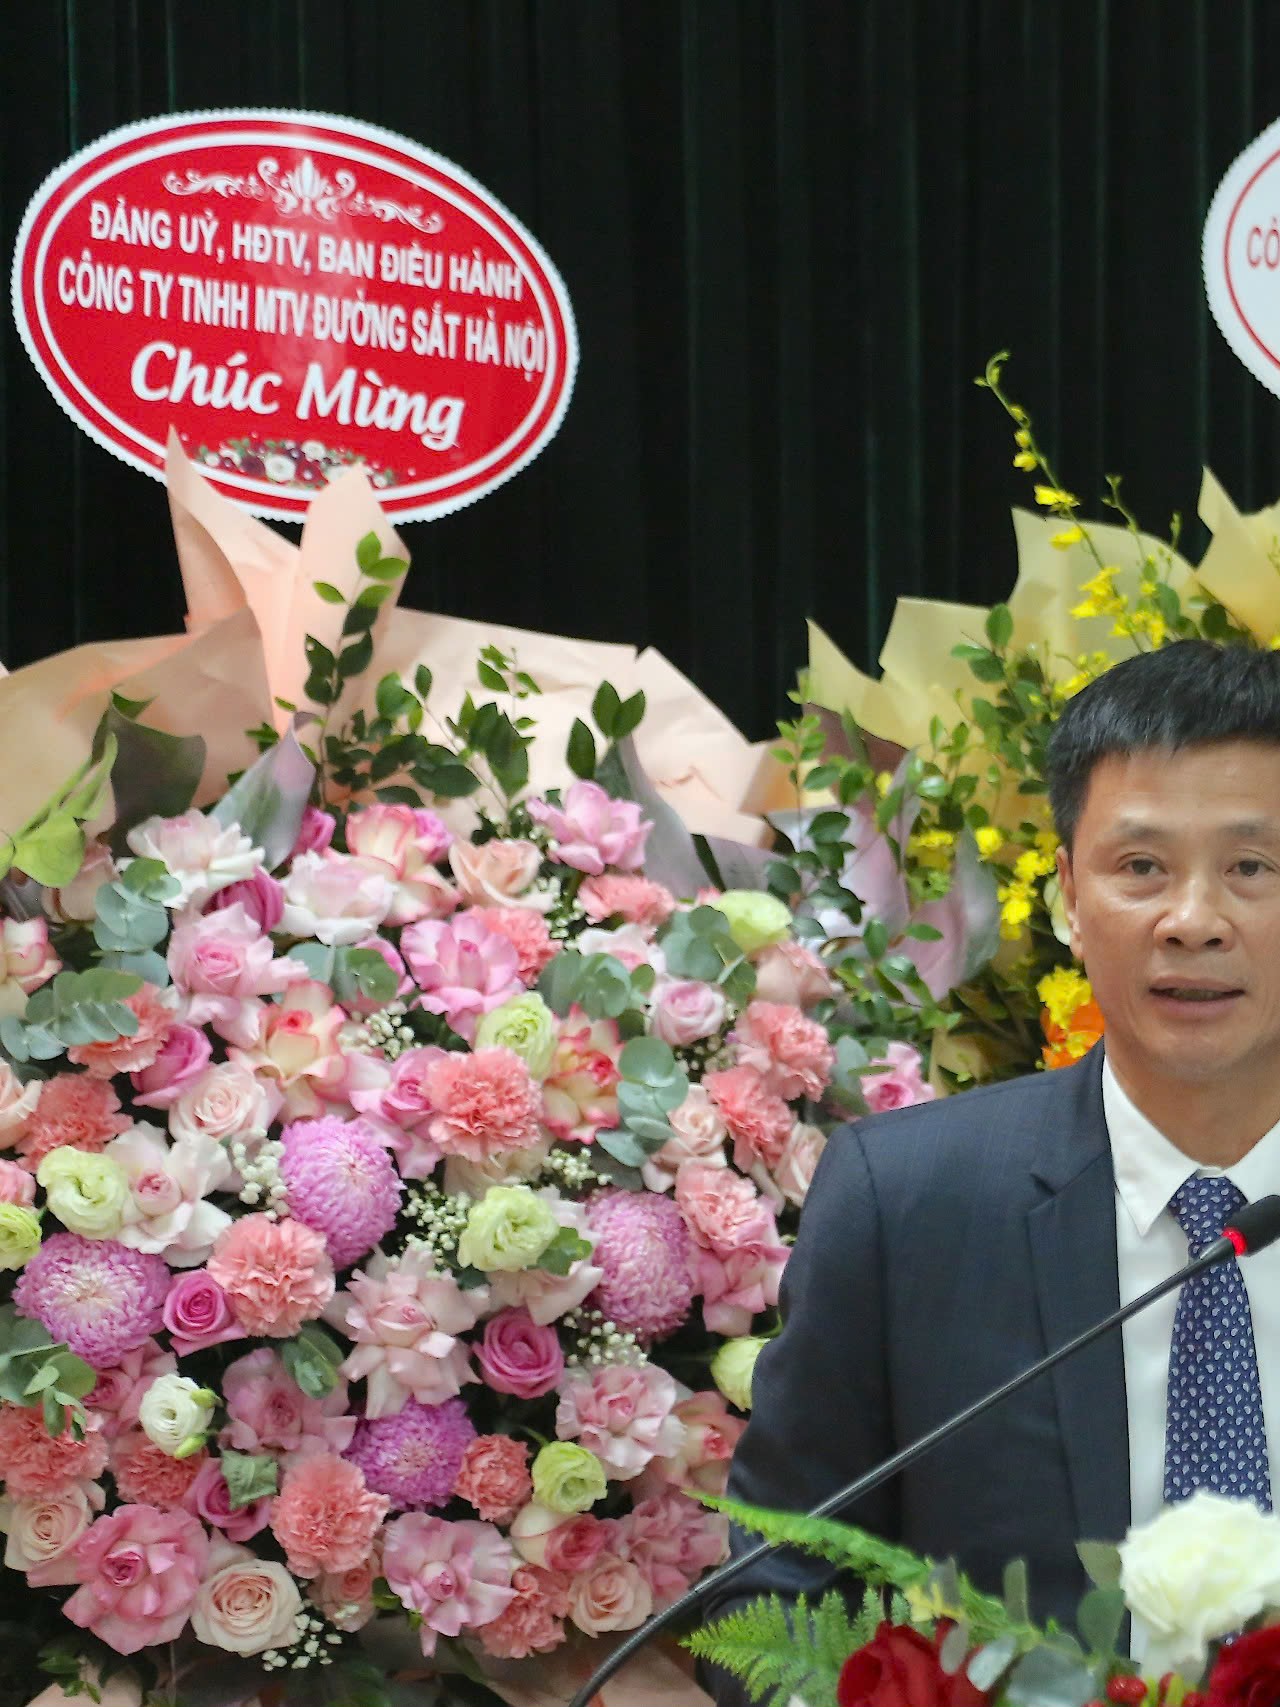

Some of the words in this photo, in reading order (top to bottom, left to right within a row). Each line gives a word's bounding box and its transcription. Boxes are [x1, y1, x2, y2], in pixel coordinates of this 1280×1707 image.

[90, 195, 173, 250] ĐẢNG
[232, 221, 312, 276] HĐTV,
[318, 234, 374, 280] BAN
[380, 240, 443, 290] ĐIỀU
[450, 248, 523, 302] HÀNH
[58, 248, 134, 315] CÔNG
[139, 269, 173, 320] TY
[178, 274, 249, 331] TNHH
[255, 285, 309, 338] MTV
[313, 288, 407, 353] ĐƯỜNG
[411, 301, 461, 360] SẮT
[465, 306, 501, 367] HÀ
[504, 319, 545, 383] NỘI
[131, 341, 283, 415] Chúc
[297, 362, 465, 452] Mừng
